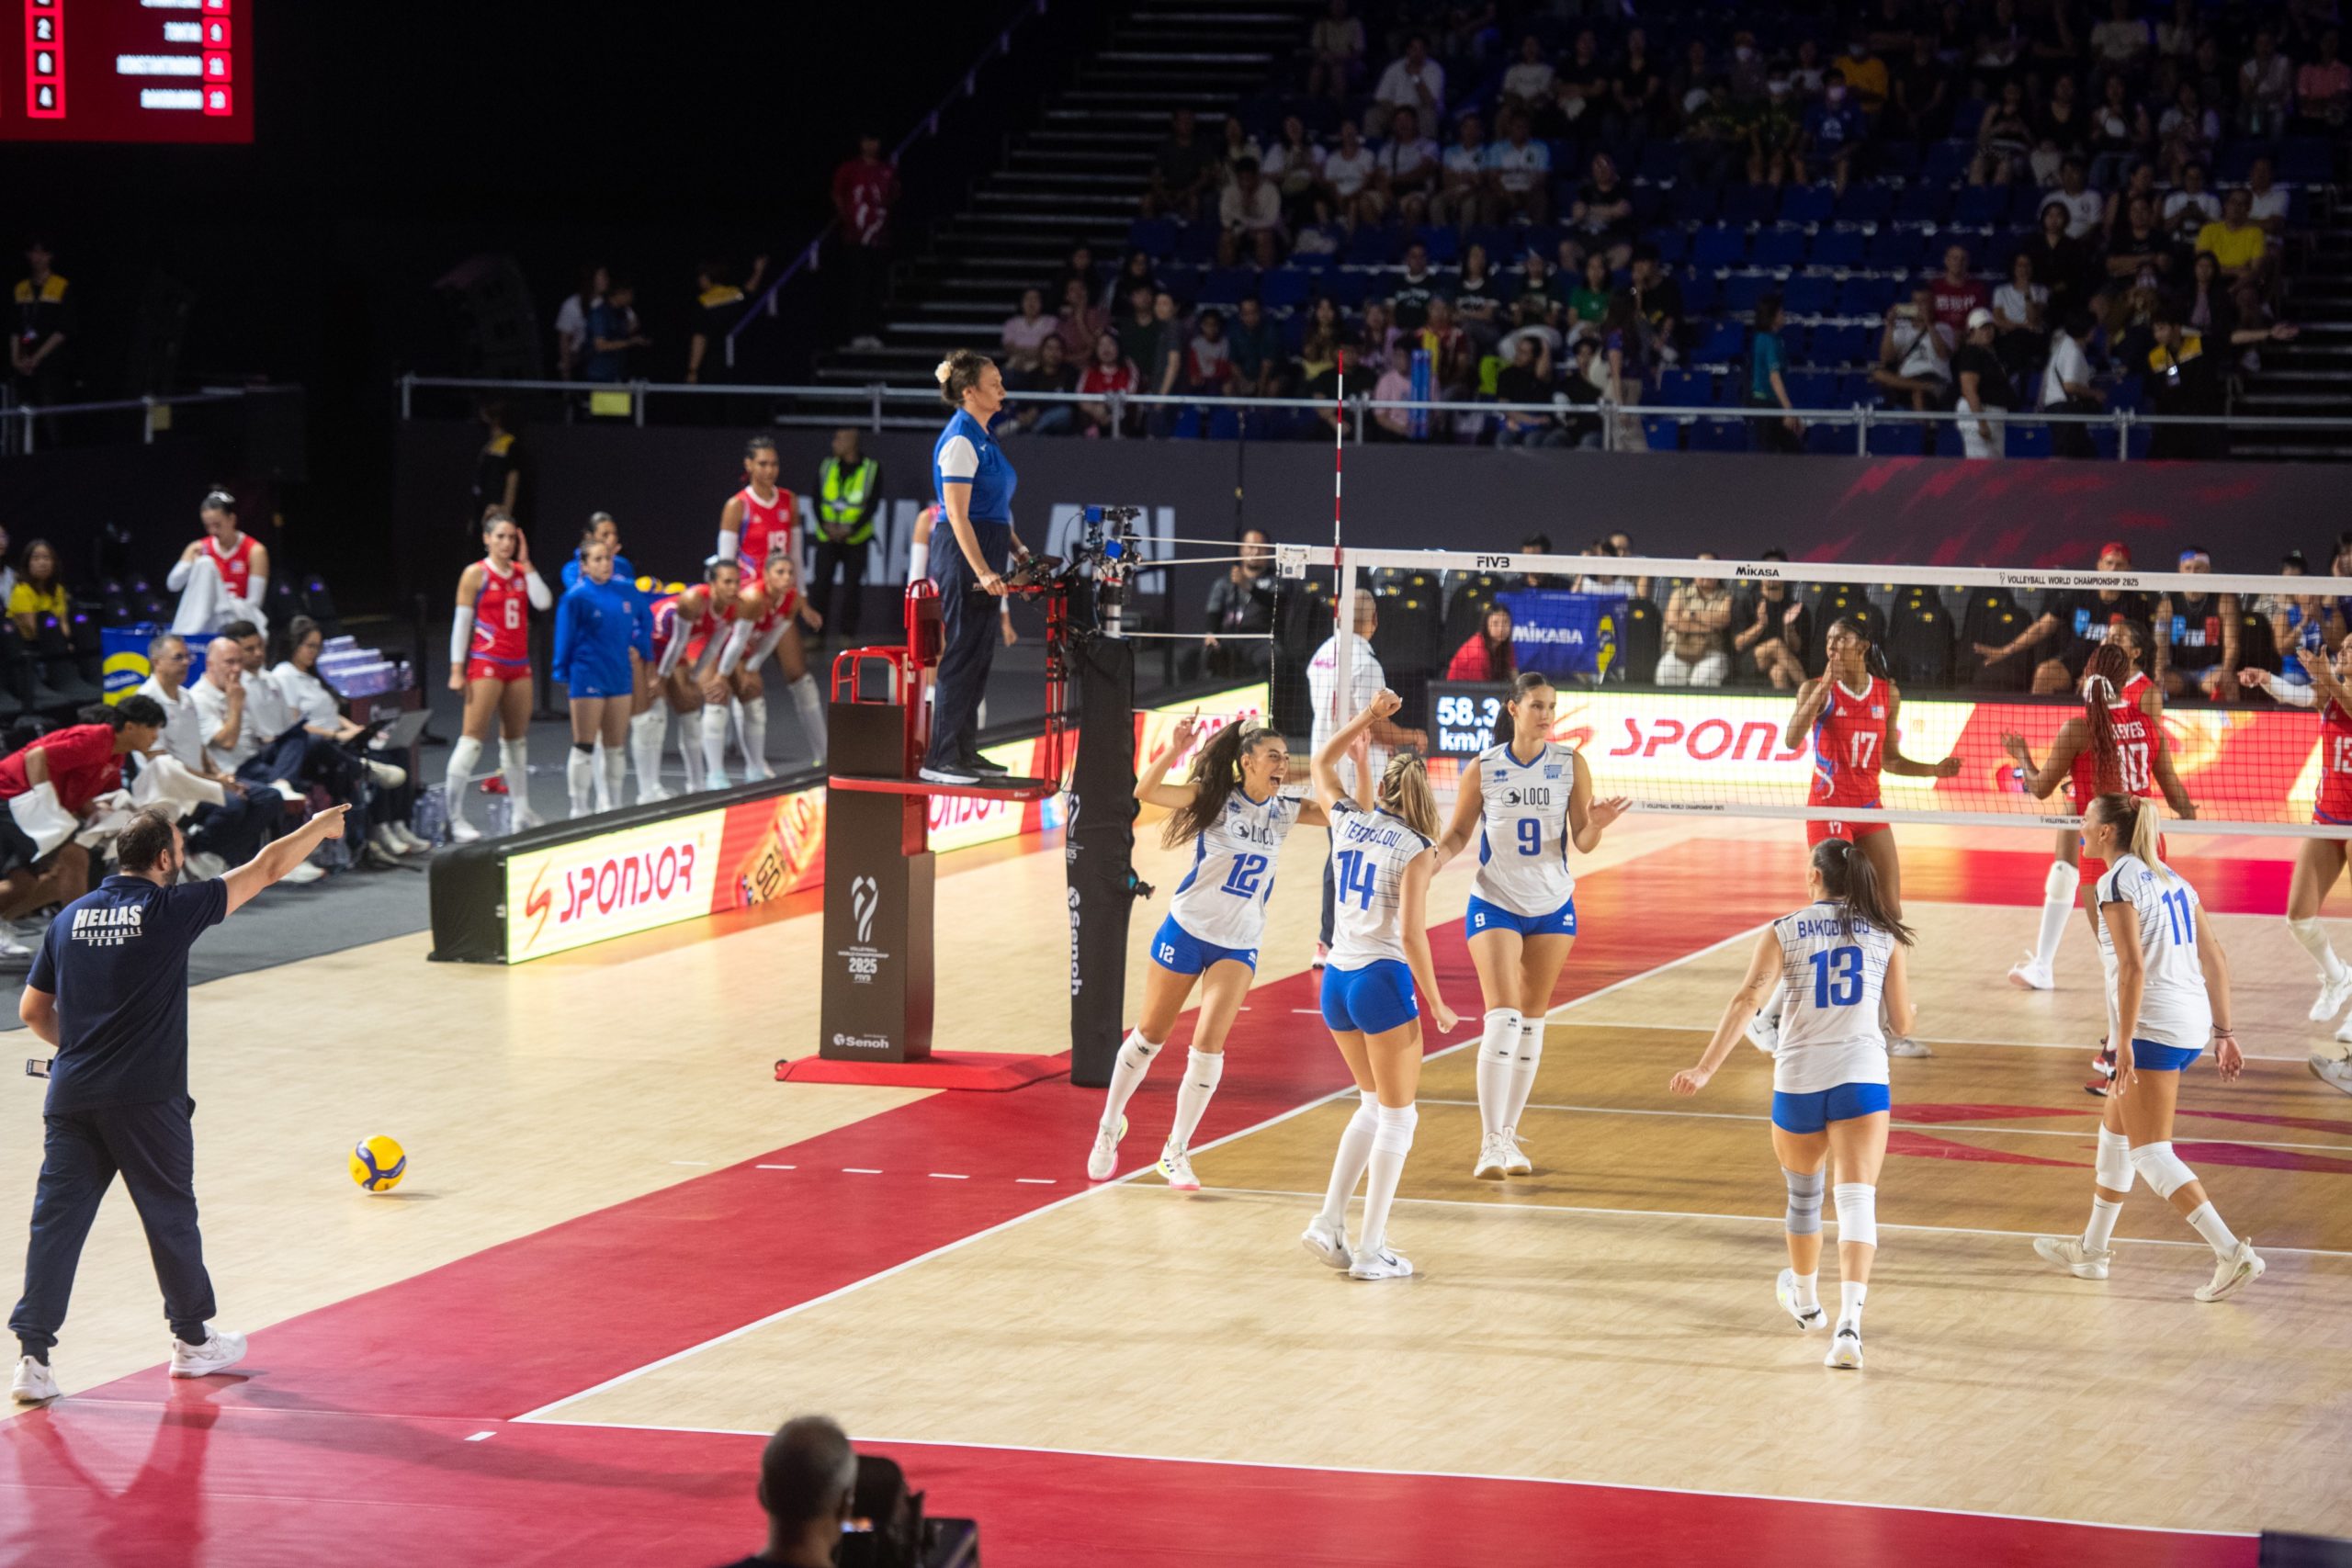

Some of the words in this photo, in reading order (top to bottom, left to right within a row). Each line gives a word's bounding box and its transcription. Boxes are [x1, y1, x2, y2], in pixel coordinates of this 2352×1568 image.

[1476, 557, 1510, 569] FIVB
[2007, 575, 2045, 584] VOLLEYBALL
[2048, 577, 2071, 585] WORLD
[2074, 576, 2120, 586] CHAMPIONSHIP
[2122, 578, 2139, 586] 2025
[504, 598, 520, 629] 6
[1851, 731, 1878, 768] 17
[1523, 787, 1550, 806] LOCO
[1251, 825, 1273, 845] LOCO
[1517, 818, 1542, 855] 9
[560, 843, 695, 923] SPONSOR
[1223, 853, 1268, 896] 12
[1338, 850, 1376, 911] 14
[72, 905, 142, 931] HELLAS
[1474, 912, 1487, 928] 9
[2161, 887, 2193, 945] 11
[72, 927, 142, 938] VOLLEYBALL
[88, 937, 125, 946] TEAM
[1069, 910, 1082, 996] Senoh
[1158, 942, 1176, 964] 12
[848, 957, 878, 974] 2025
[1809, 945, 1863, 1009] 13
[845, 1036, 889, 1049] Senoh
